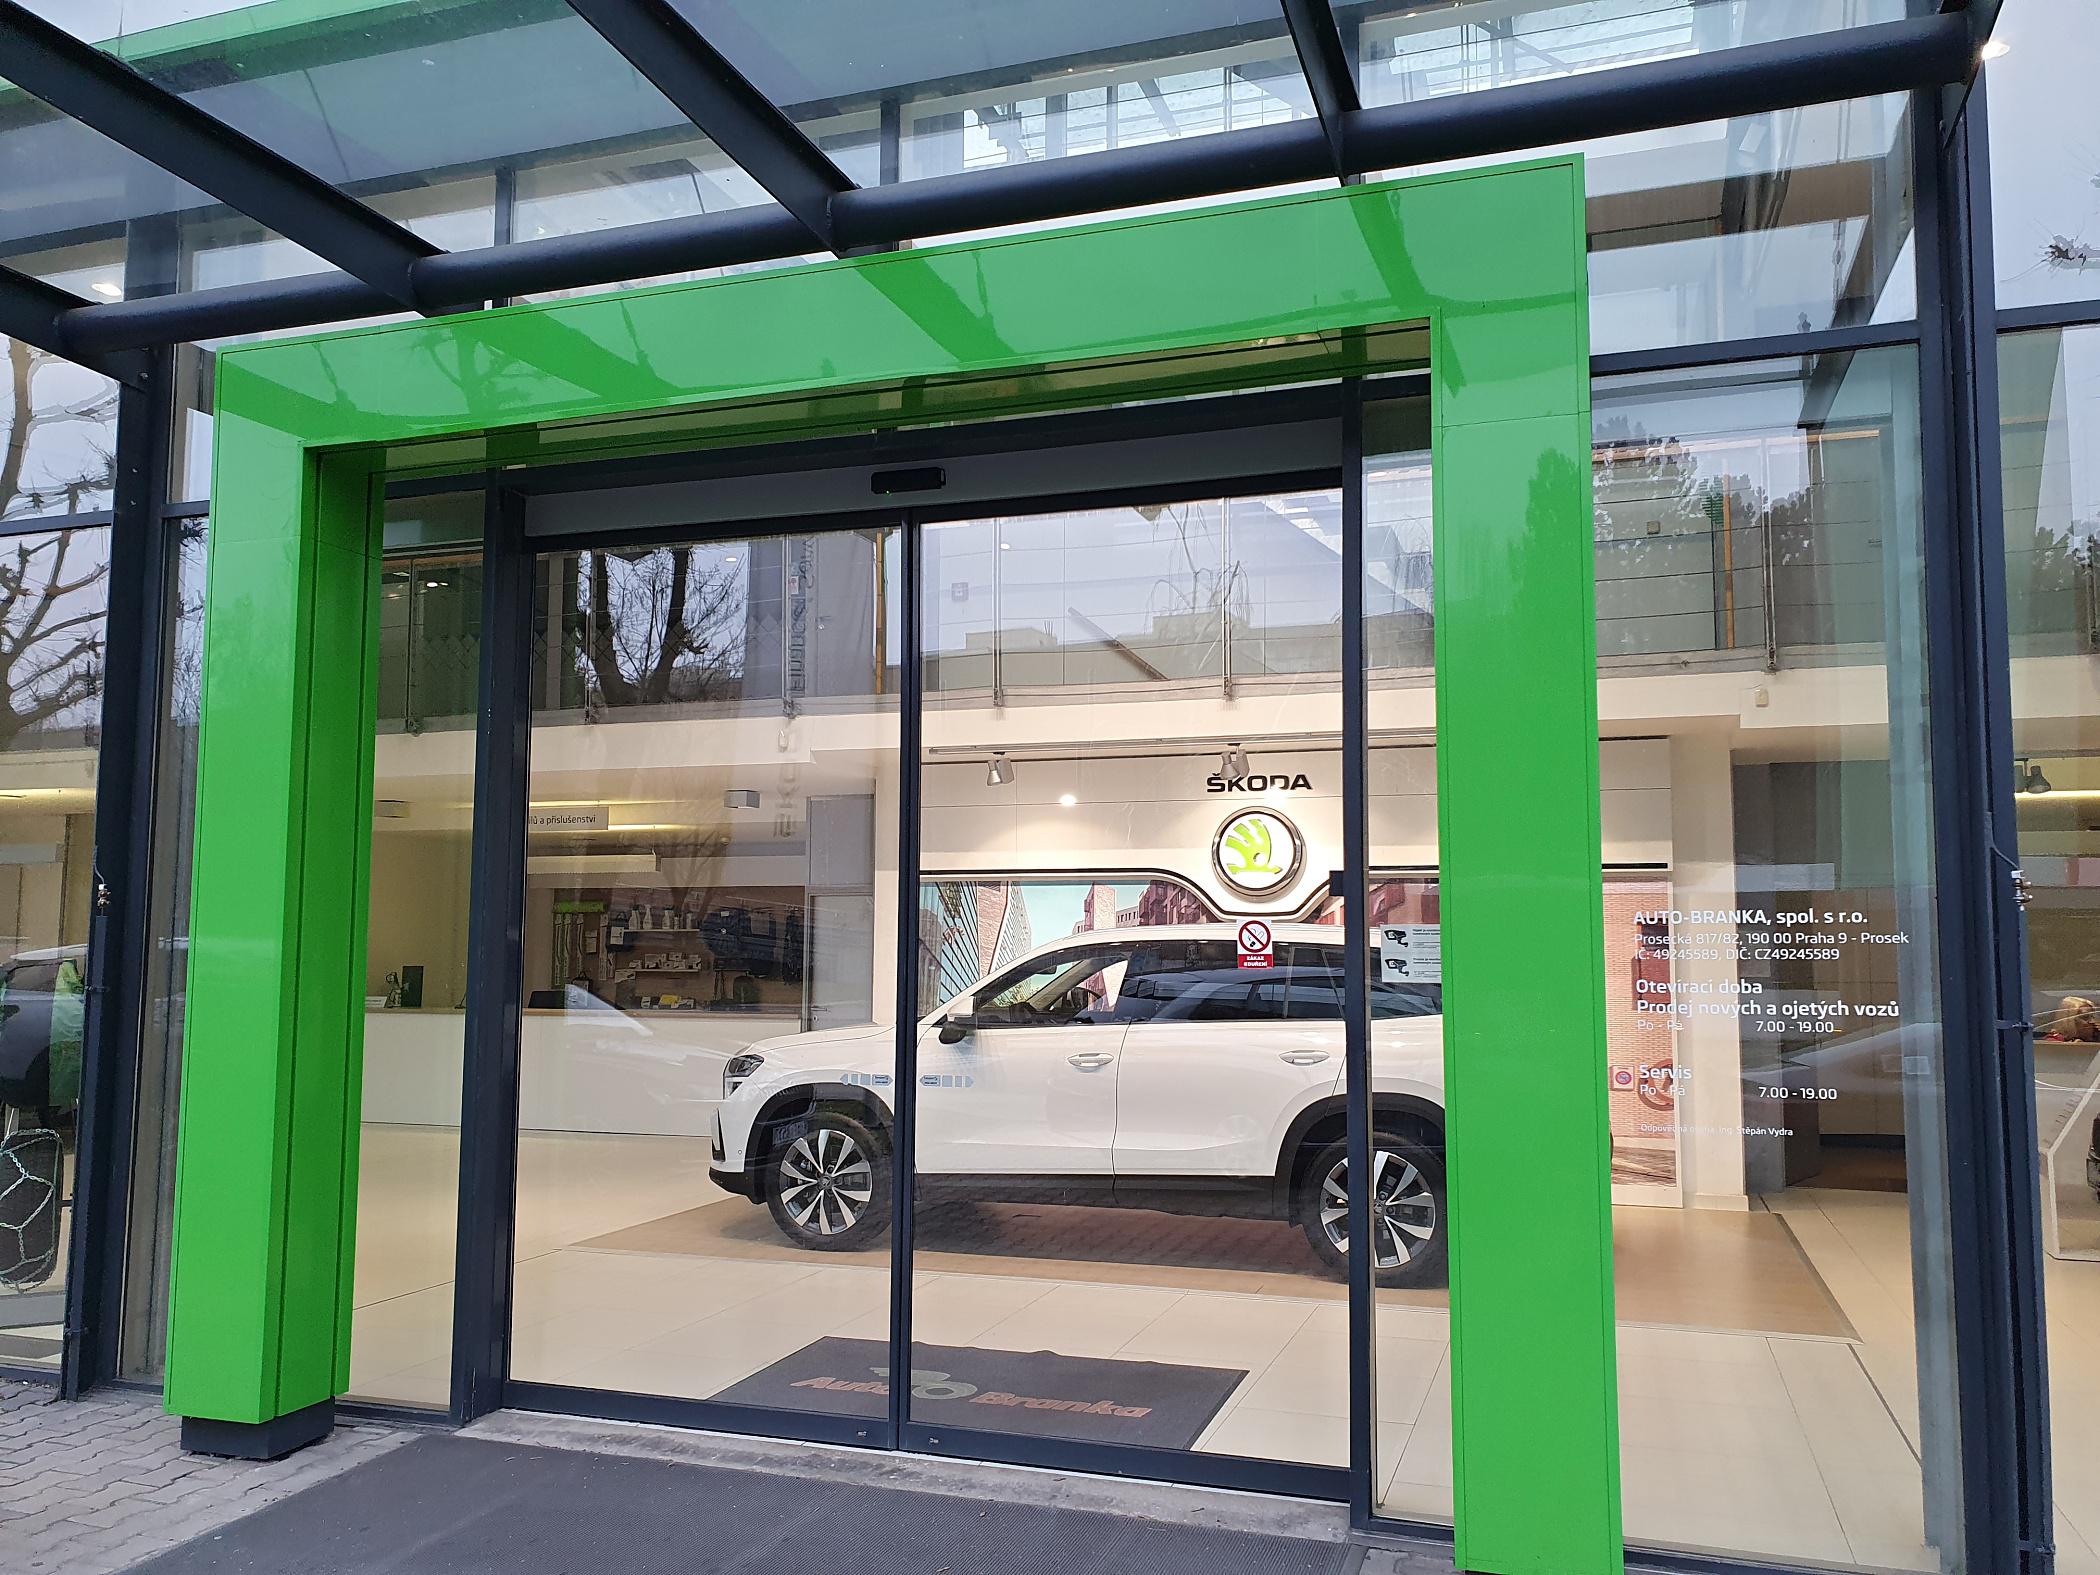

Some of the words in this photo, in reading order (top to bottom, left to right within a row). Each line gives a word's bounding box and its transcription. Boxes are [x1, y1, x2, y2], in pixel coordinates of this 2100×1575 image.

[1206, 773, 1314, 793] ŠKODA
[1634, 910, 1772, 926] AUTO-BRANKA,
[1776, 907, 1819, 928] spol.
[1823, 911, 1834, 924] s
[1838, 911, 1868, 923] r.o.
[1634, 932, 1692, 945] Prosecká
[1696, 933, 1743, 945] 817/82,
[1745, 933, 1770, 944] 190
[1773, 932, 1792, 944] 00
[1795, 932, 1835, 944] Praha
[1838, 932, 1848, 944] 9
[1861, 931, 1910, 944] Prosek
[1653, 948, 1722, 960] 49245589,
[1726, 946, 1752, 960] DIČ:
[1754, 948, 1840, 960] CZ49245589
[1636, 979, 1713, 994] Otevírací
[1719, 978, 1763, 994] doba
[1637, 1000, 1693, 1018] Prodej
[1698, 1000, 1762, 1019] nových
[1766, 1003, 1777, 1015] a
[1781, 1000, 1850, 1020] ojetých
[1854, 1000, 1900, 1017] vozů
[1756, 1020, 1785, 1033] 7.00
[1796, 1021, 1834, 1033] 19.00
[1639, 1064, 1693, 1079] Servis
[1640, 1084, 1657, 1096] Po
[1758, 1086, 1789, 1099] 7.00
[1800, 1087, 1838, 1100] 19.00
[1767, 1127, 1794, 1137] Vydra
[968, 1390, 1153, 1419] Branka
